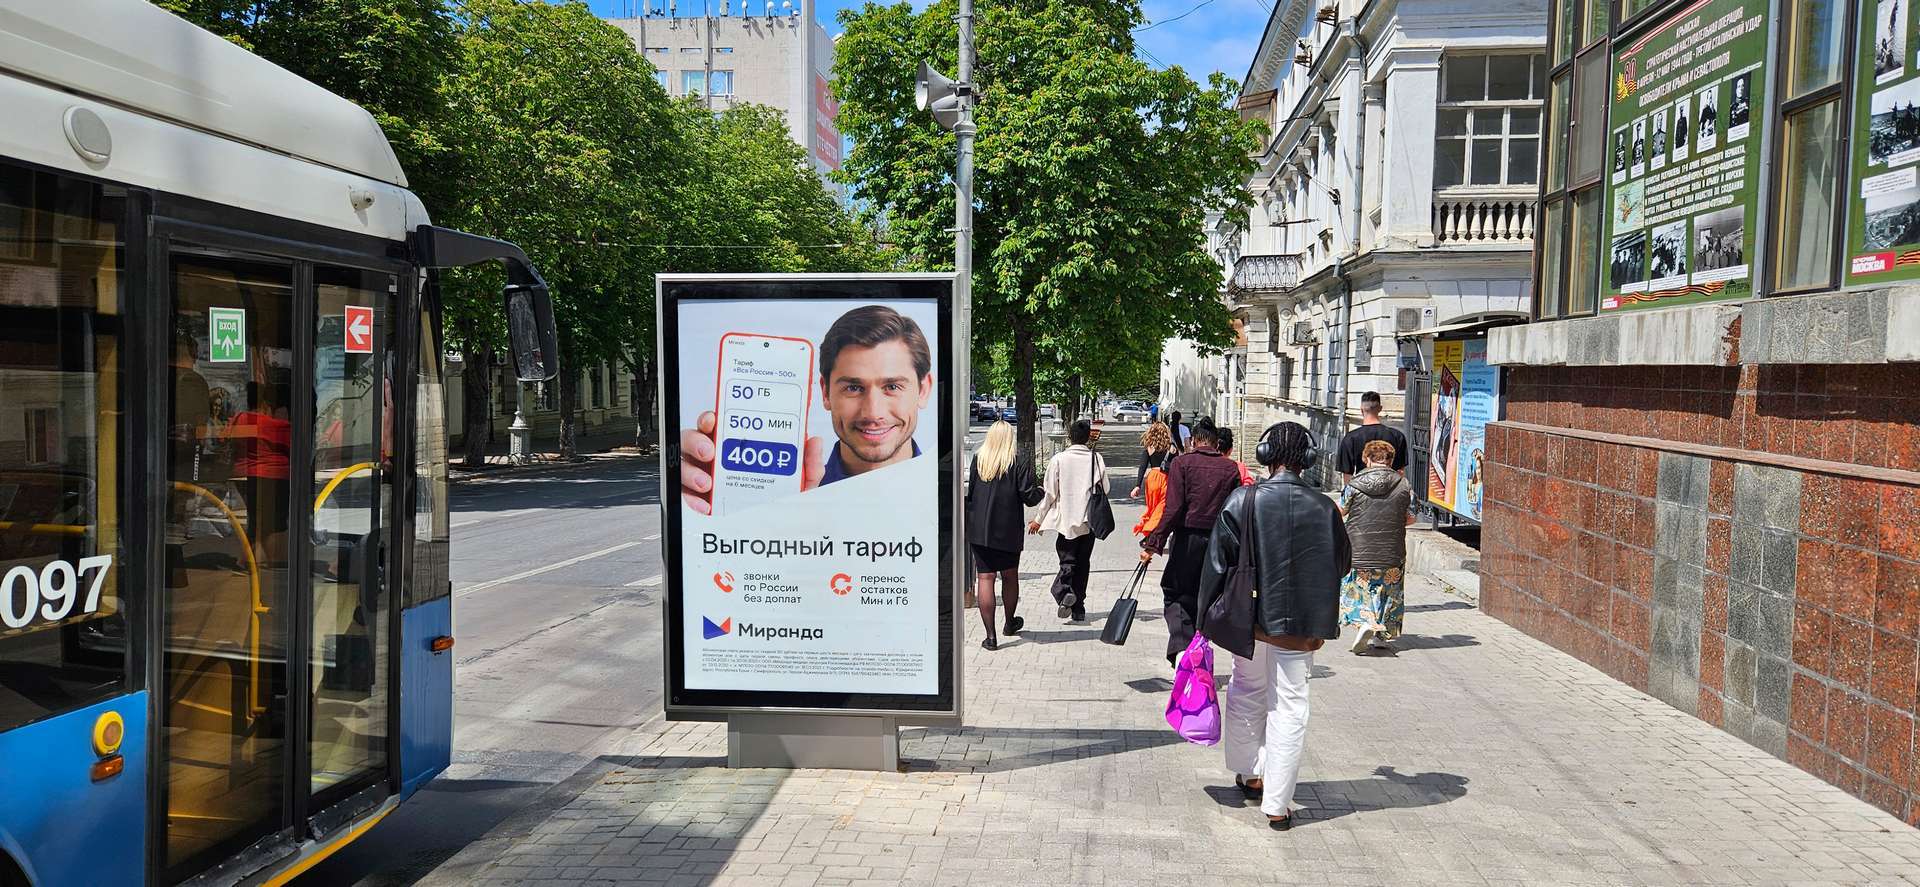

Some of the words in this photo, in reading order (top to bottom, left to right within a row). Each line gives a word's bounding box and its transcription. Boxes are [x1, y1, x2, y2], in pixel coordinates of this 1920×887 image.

[1745, 14, 1762, 33] УДАР
[1851, 260, 1885, 274] МОСКВА
[219, 321, 236, 332] ВХОД
[734, 359, 754, 367] Тариф
[750, 368, 774, 376] Россия
[732, 385, 753, 399] 50
[758, 388, 771, 397] ГБ
[729, 415, 763, 430] 500
[768, 419, 792, 429] МИН
[750, 476, 775, 484] скидкой
[702, 533, 833, 558] Выгодный
[842, 537, 923, 562] тариф
[743, 573, 780, 581] звонки
[860, 575, 906, 585] перенос
[0, 554, 112, 628] 097
[759, 583, 798, 592] России
[743, 594, 762, 603] без
[765, 596, 802, 605] доплат
[861, 596, 883, 605] Мин
[896, 597, 909, 606] Гб
[738, 623, 824, 641] Миранда
